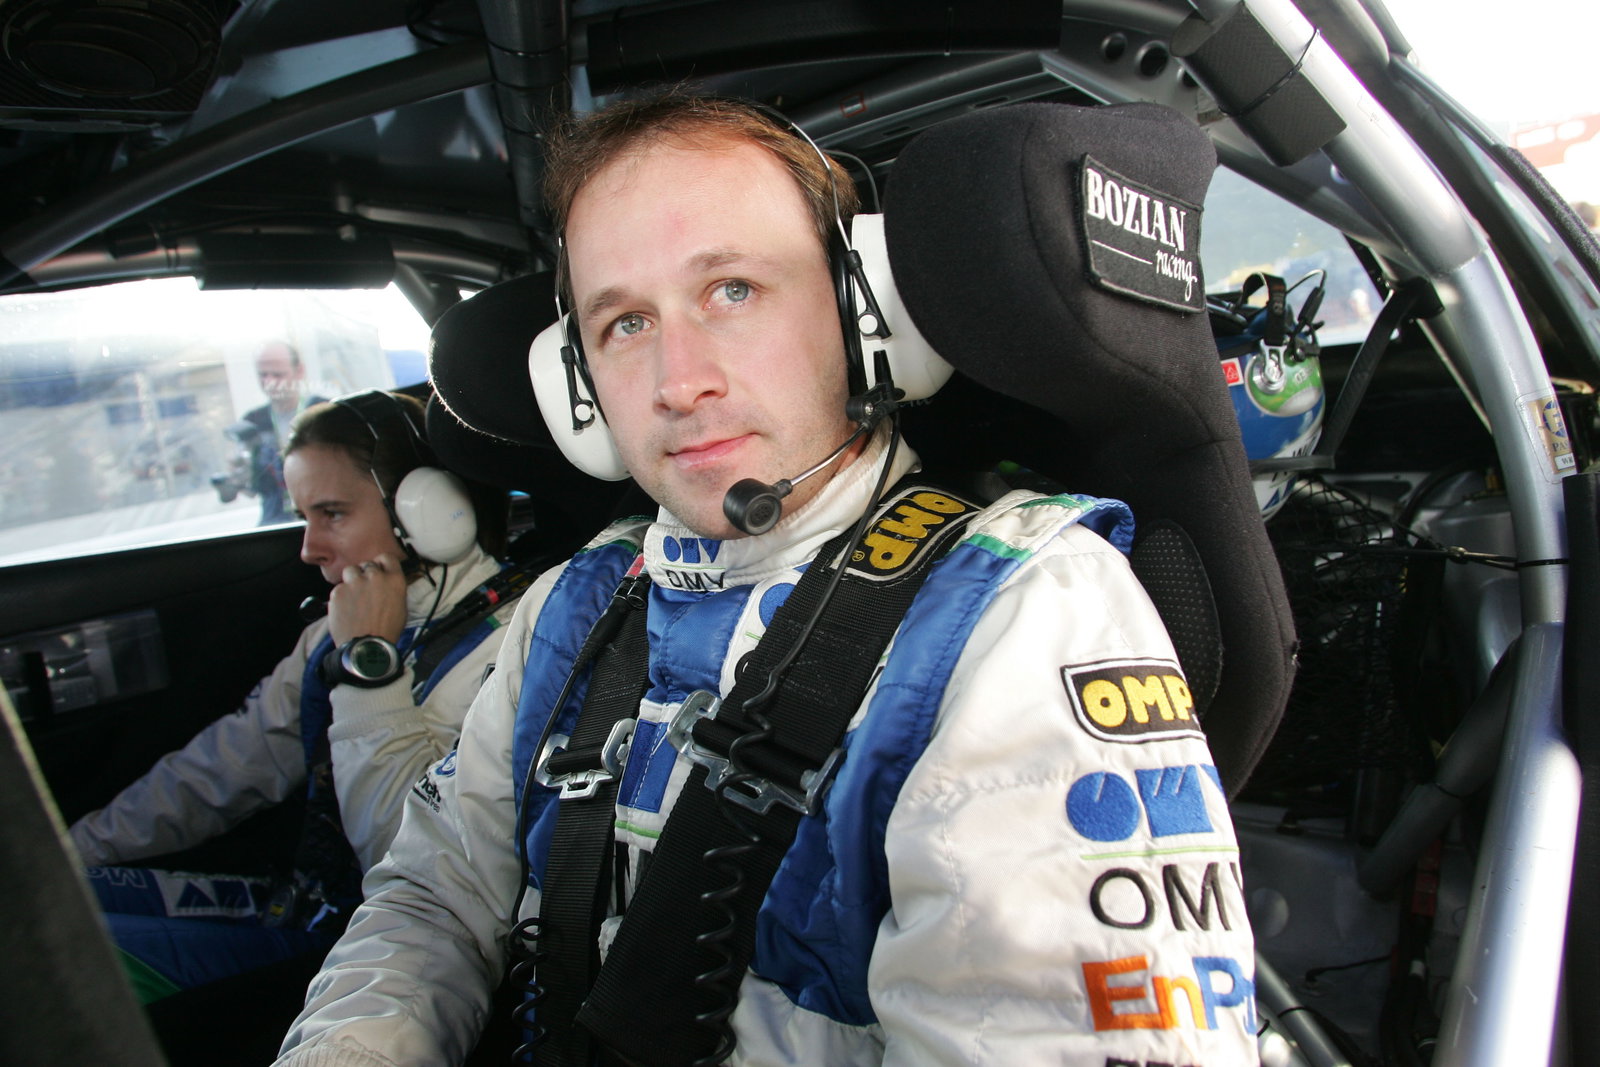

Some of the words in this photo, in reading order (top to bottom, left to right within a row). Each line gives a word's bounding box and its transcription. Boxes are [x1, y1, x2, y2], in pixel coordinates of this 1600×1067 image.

[1087, 168, 1186, 252] BOZIAN
[1156, 248, 1198, 302] racing
[864, 492, 966, 571] OMP
[1065, 763, 1229, 843] OM
[1088, 862, 1245, 931] OM
